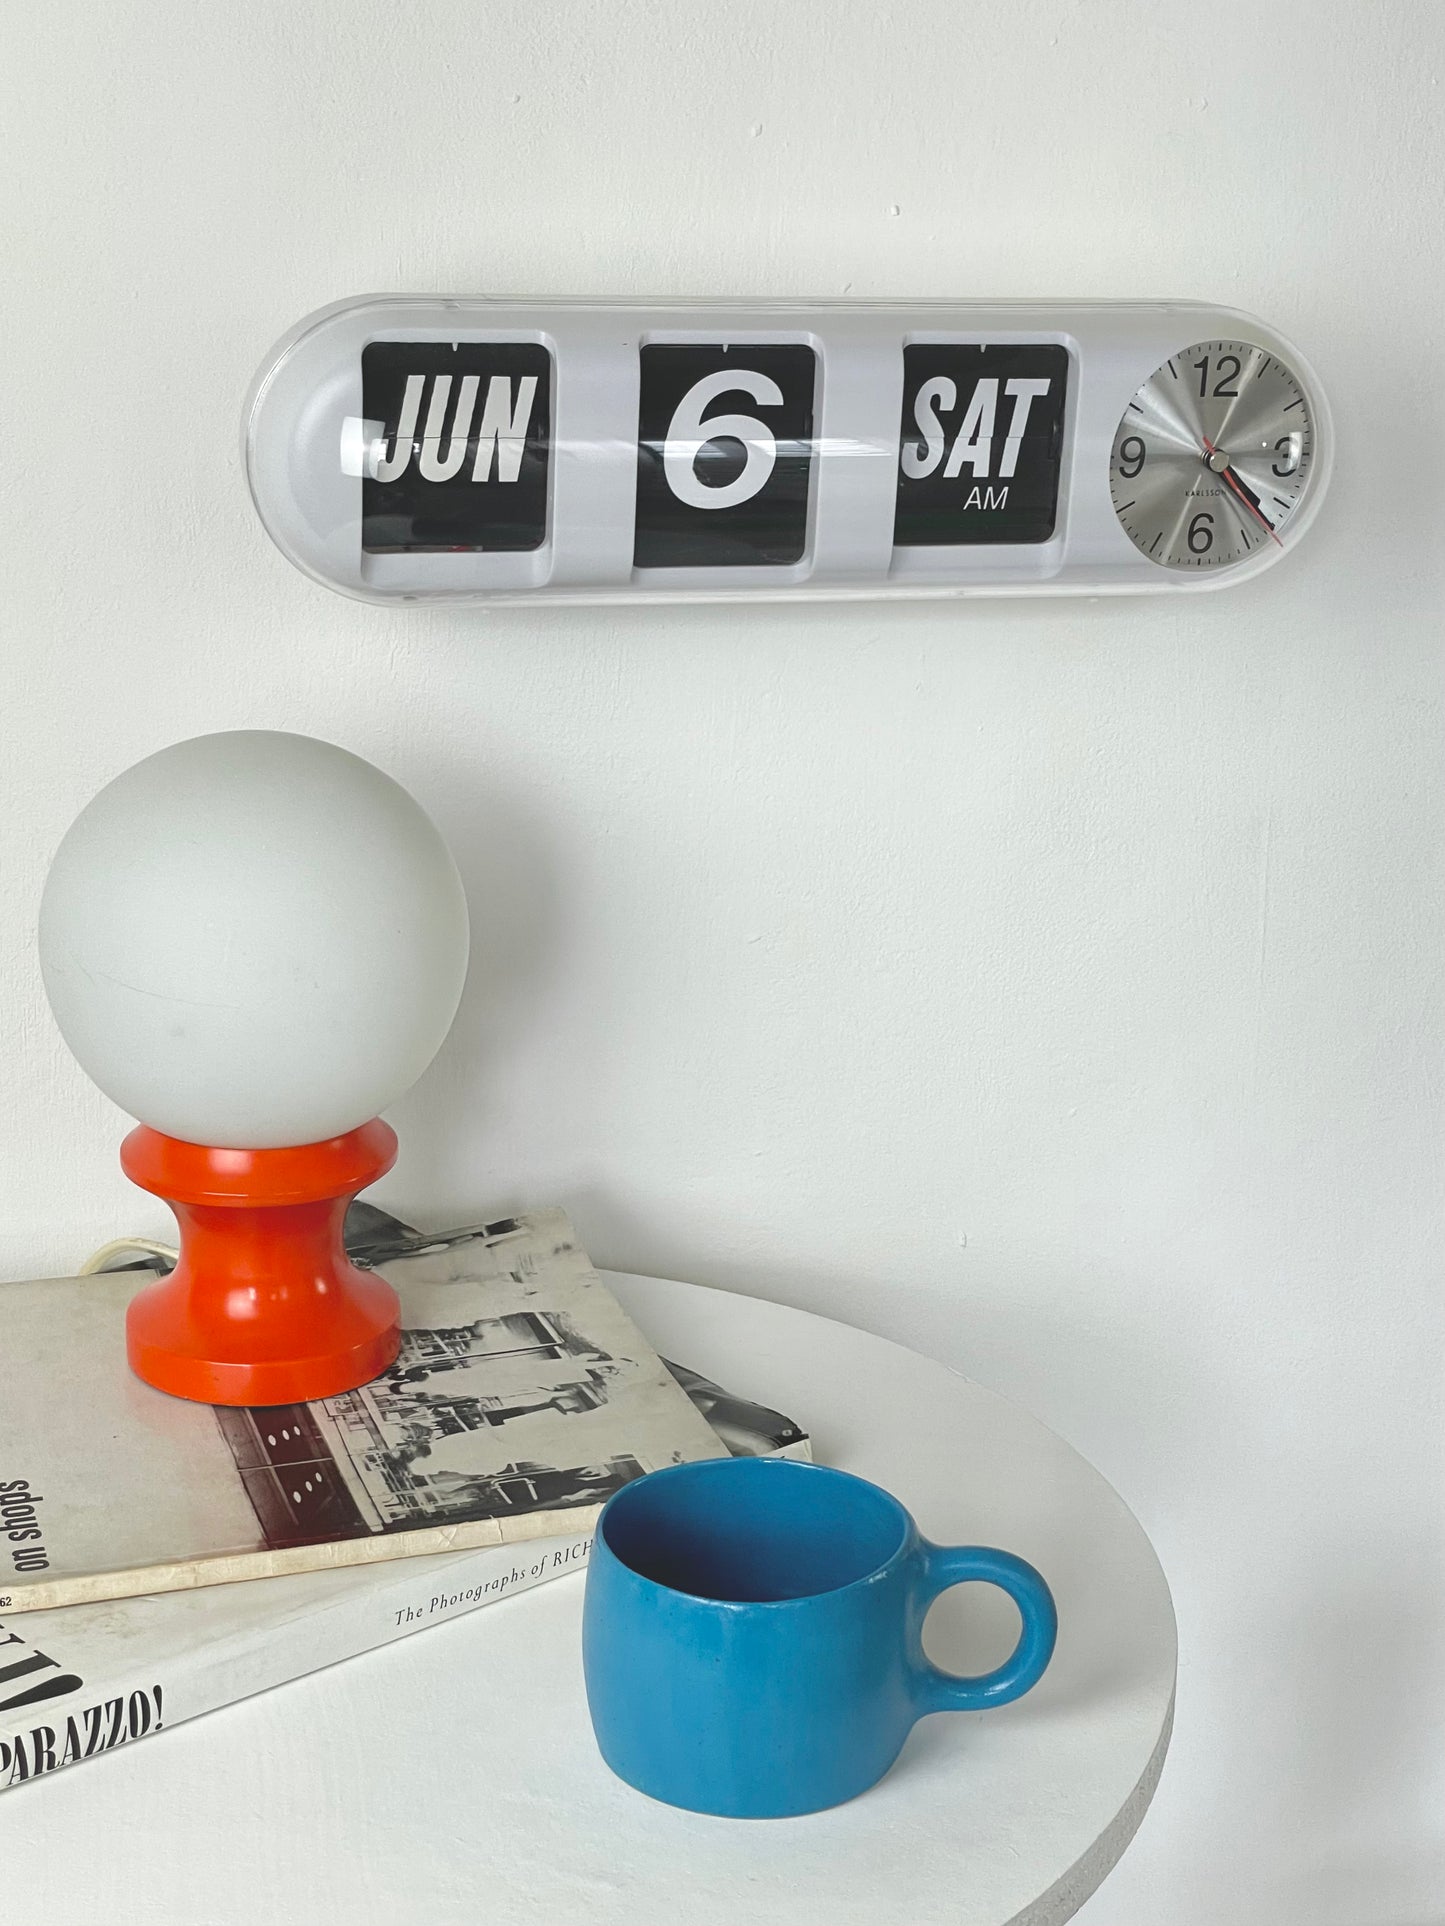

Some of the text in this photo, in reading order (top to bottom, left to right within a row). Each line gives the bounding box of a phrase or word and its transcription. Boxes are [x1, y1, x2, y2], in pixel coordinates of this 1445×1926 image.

[1194, 356, 1241, 397] 12
[373, 375, 539, 483] JUN
[663, 369, 784, 509] 6
[901, 376, 1051, 479] SAT
[1119, 436, 1146, 478] 9
[1271, 436, 1298, 477] 3
[963, 486, 1009, 510] AM
[1187, 513, 1214, 553] 6
[0, 1480, 50, 1572] on shops
[395, 1607, 423, 1626] The
[429, 1568, 527, 1613] Photographs
[531, 1555, 548, 1579] of
